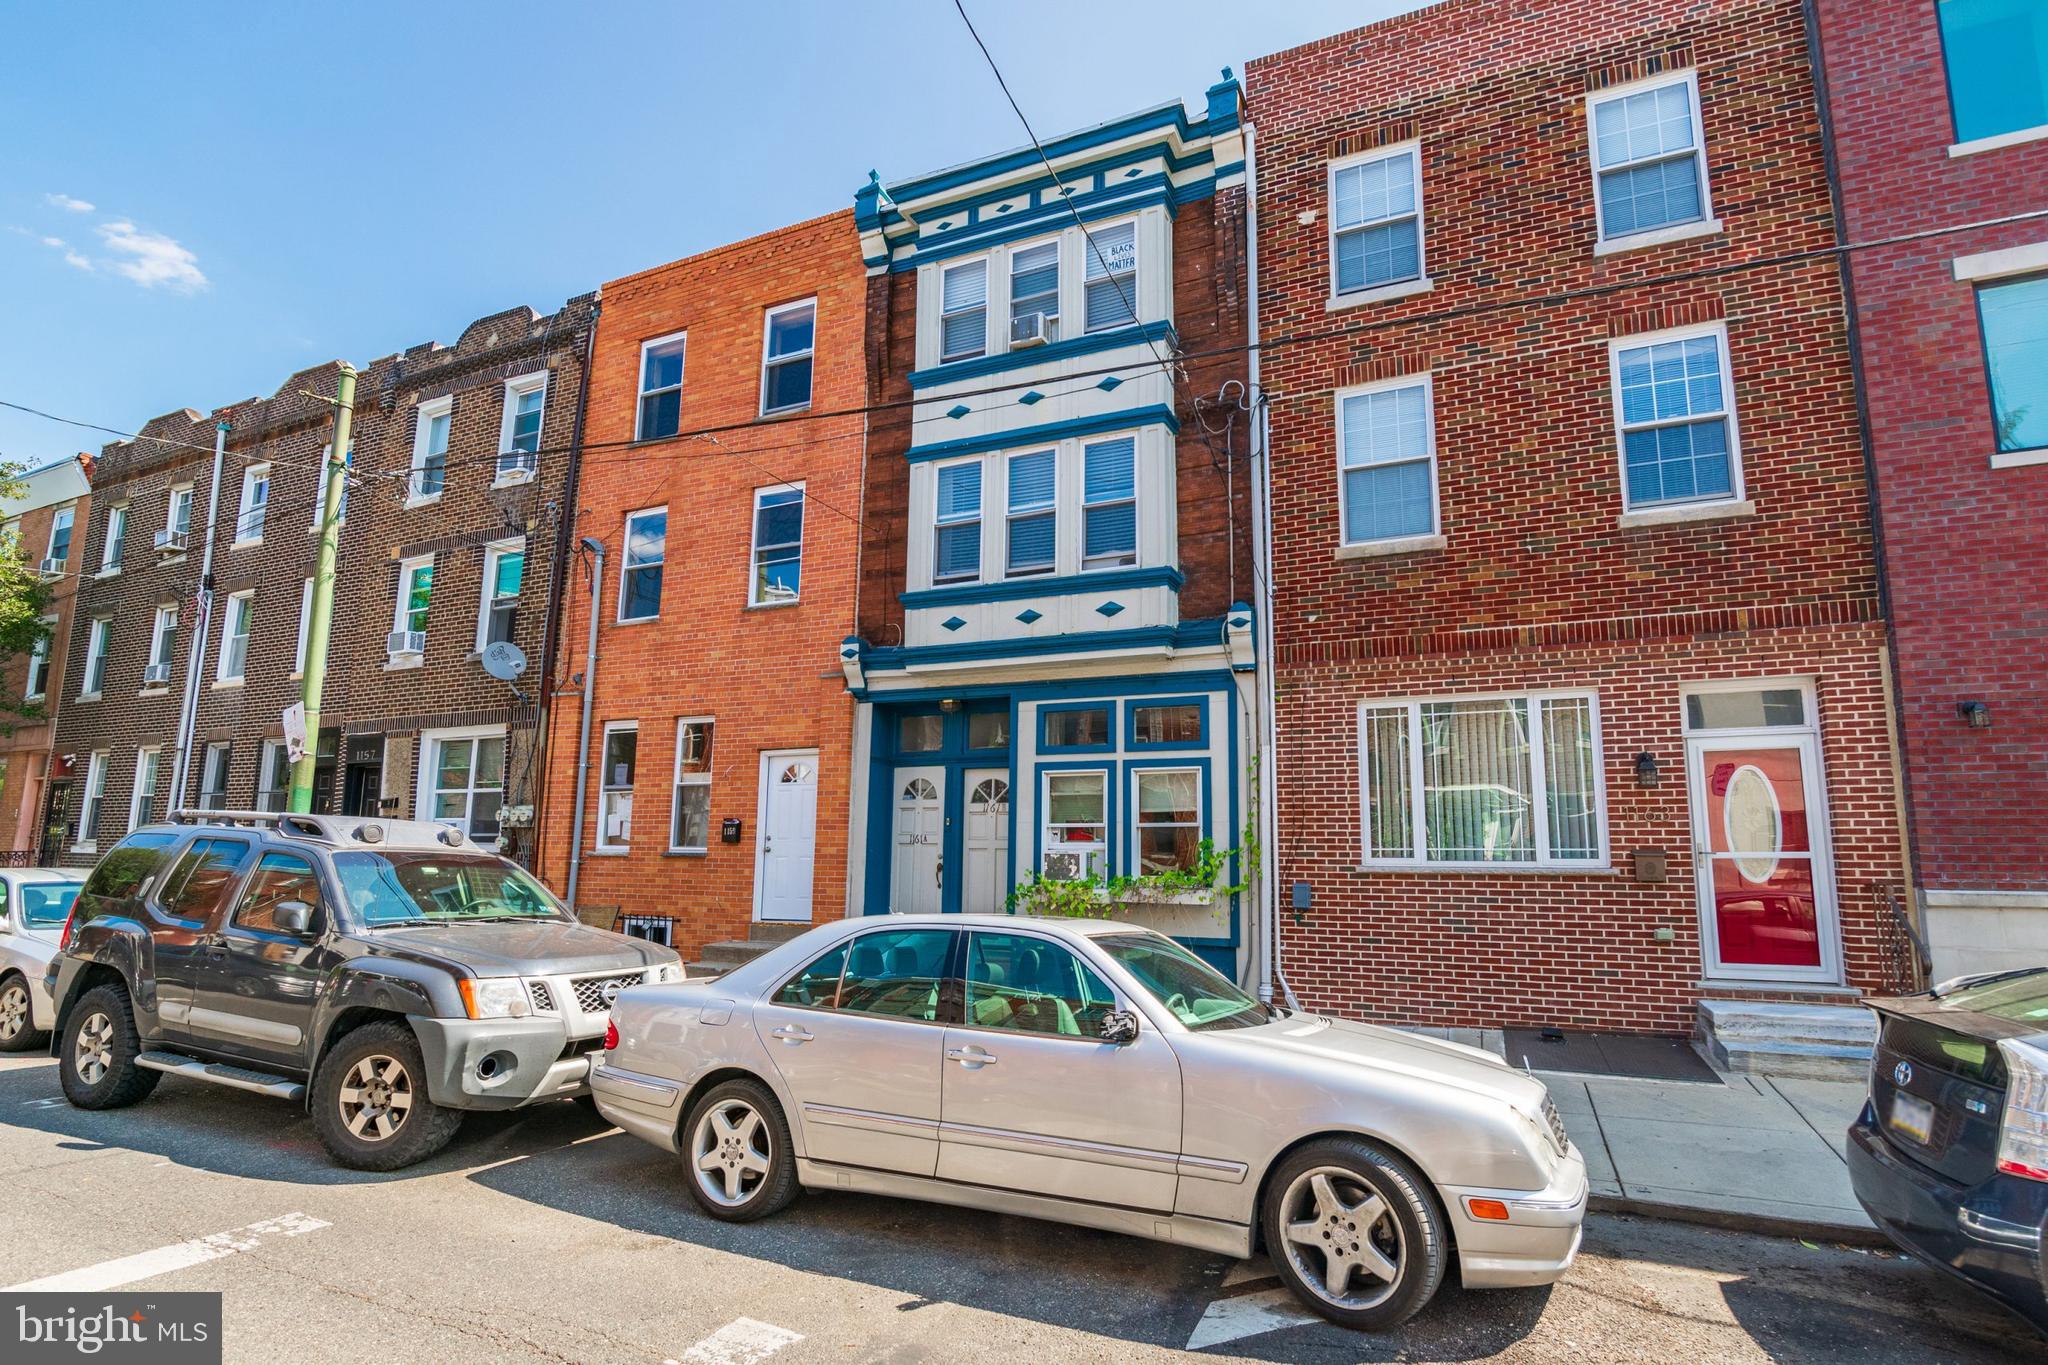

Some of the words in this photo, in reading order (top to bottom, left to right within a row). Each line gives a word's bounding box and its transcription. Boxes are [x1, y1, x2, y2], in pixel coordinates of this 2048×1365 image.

[1111, 243, 1135, 256] BLACK
[356, 750, 376, 761] 1157
[1622, 805, 1671, 822] 1163
